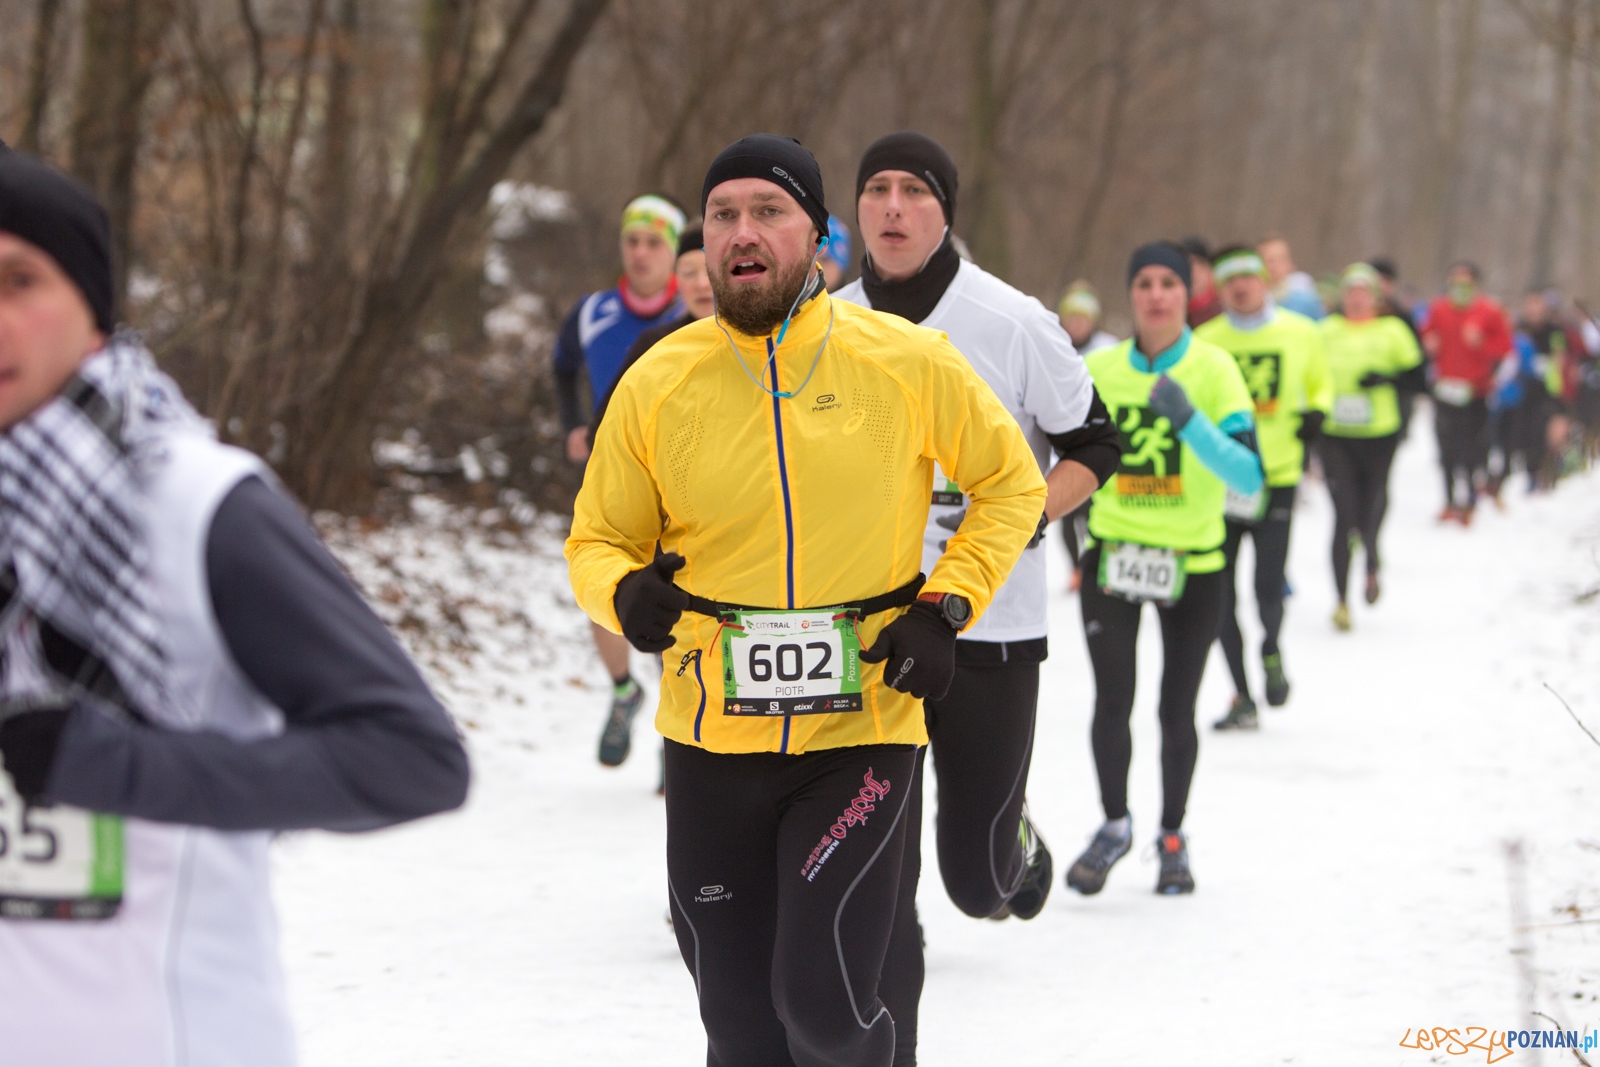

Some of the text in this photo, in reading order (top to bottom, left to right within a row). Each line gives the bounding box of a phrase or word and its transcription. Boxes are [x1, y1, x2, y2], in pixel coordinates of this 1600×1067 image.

[812, 402, 842, 412] Kalenji
[1117, 559, 1170, 587] 1410
[749, 641, 832, 682] 602
[847, 648, 856, 682] Poznań
[775, 685, 805, 696] PIOTR
[0, 800, 58, 863] 5
[807, 864, 821, 882] TEAM
[694, 891, 733, 903] Kalenji
